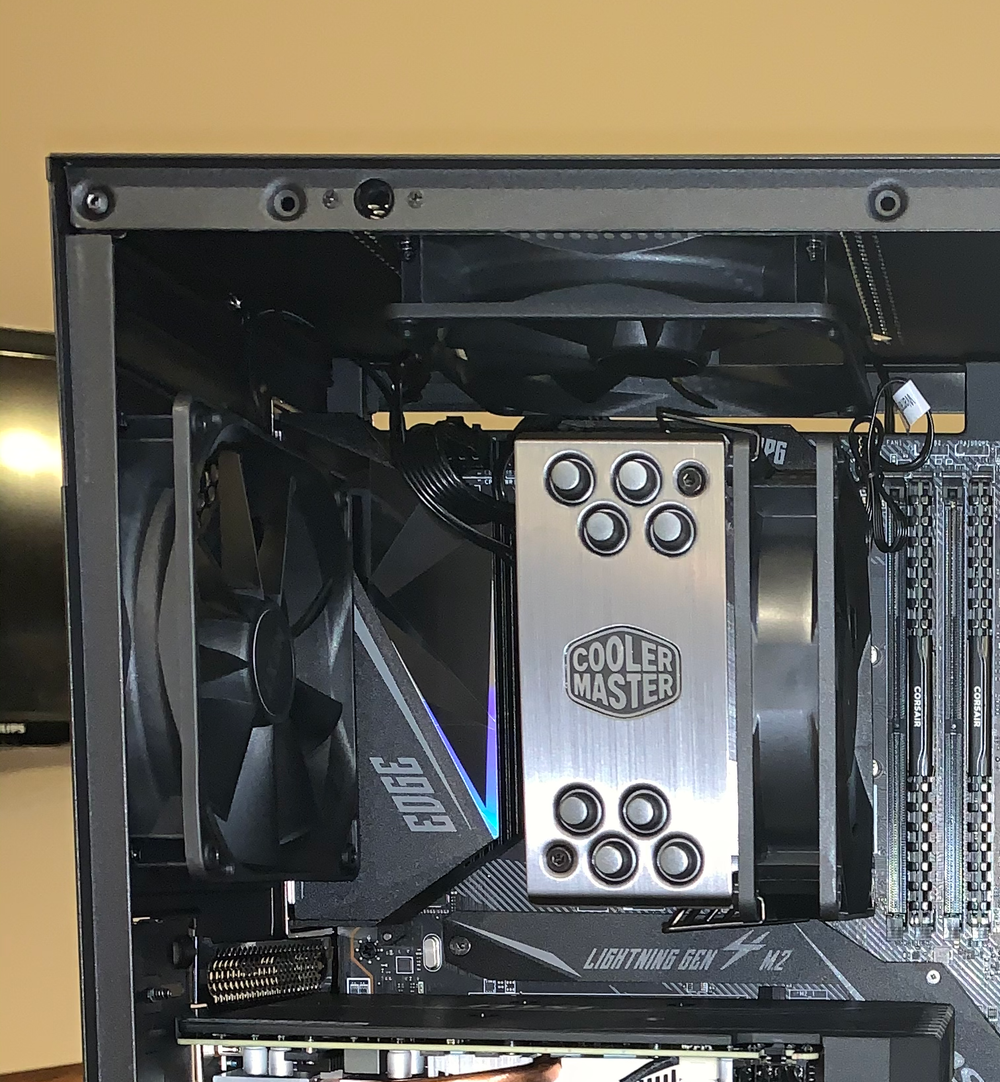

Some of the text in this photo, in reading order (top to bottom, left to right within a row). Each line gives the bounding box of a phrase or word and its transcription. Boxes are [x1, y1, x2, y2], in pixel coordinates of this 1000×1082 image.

[761, 437, 787, 465] PG
[572, 634, 673, 672] COOLER
[573, 673, 674, 710] MASTER
[913, 686, 921, 728] CORSAIR
[973, 686, 981, 728] CORSAIR
[369, 757, 457, 832] EDGE
[583, 948, 679, 970] LIGHTNING
[677, 949, 718, 971] GEN
